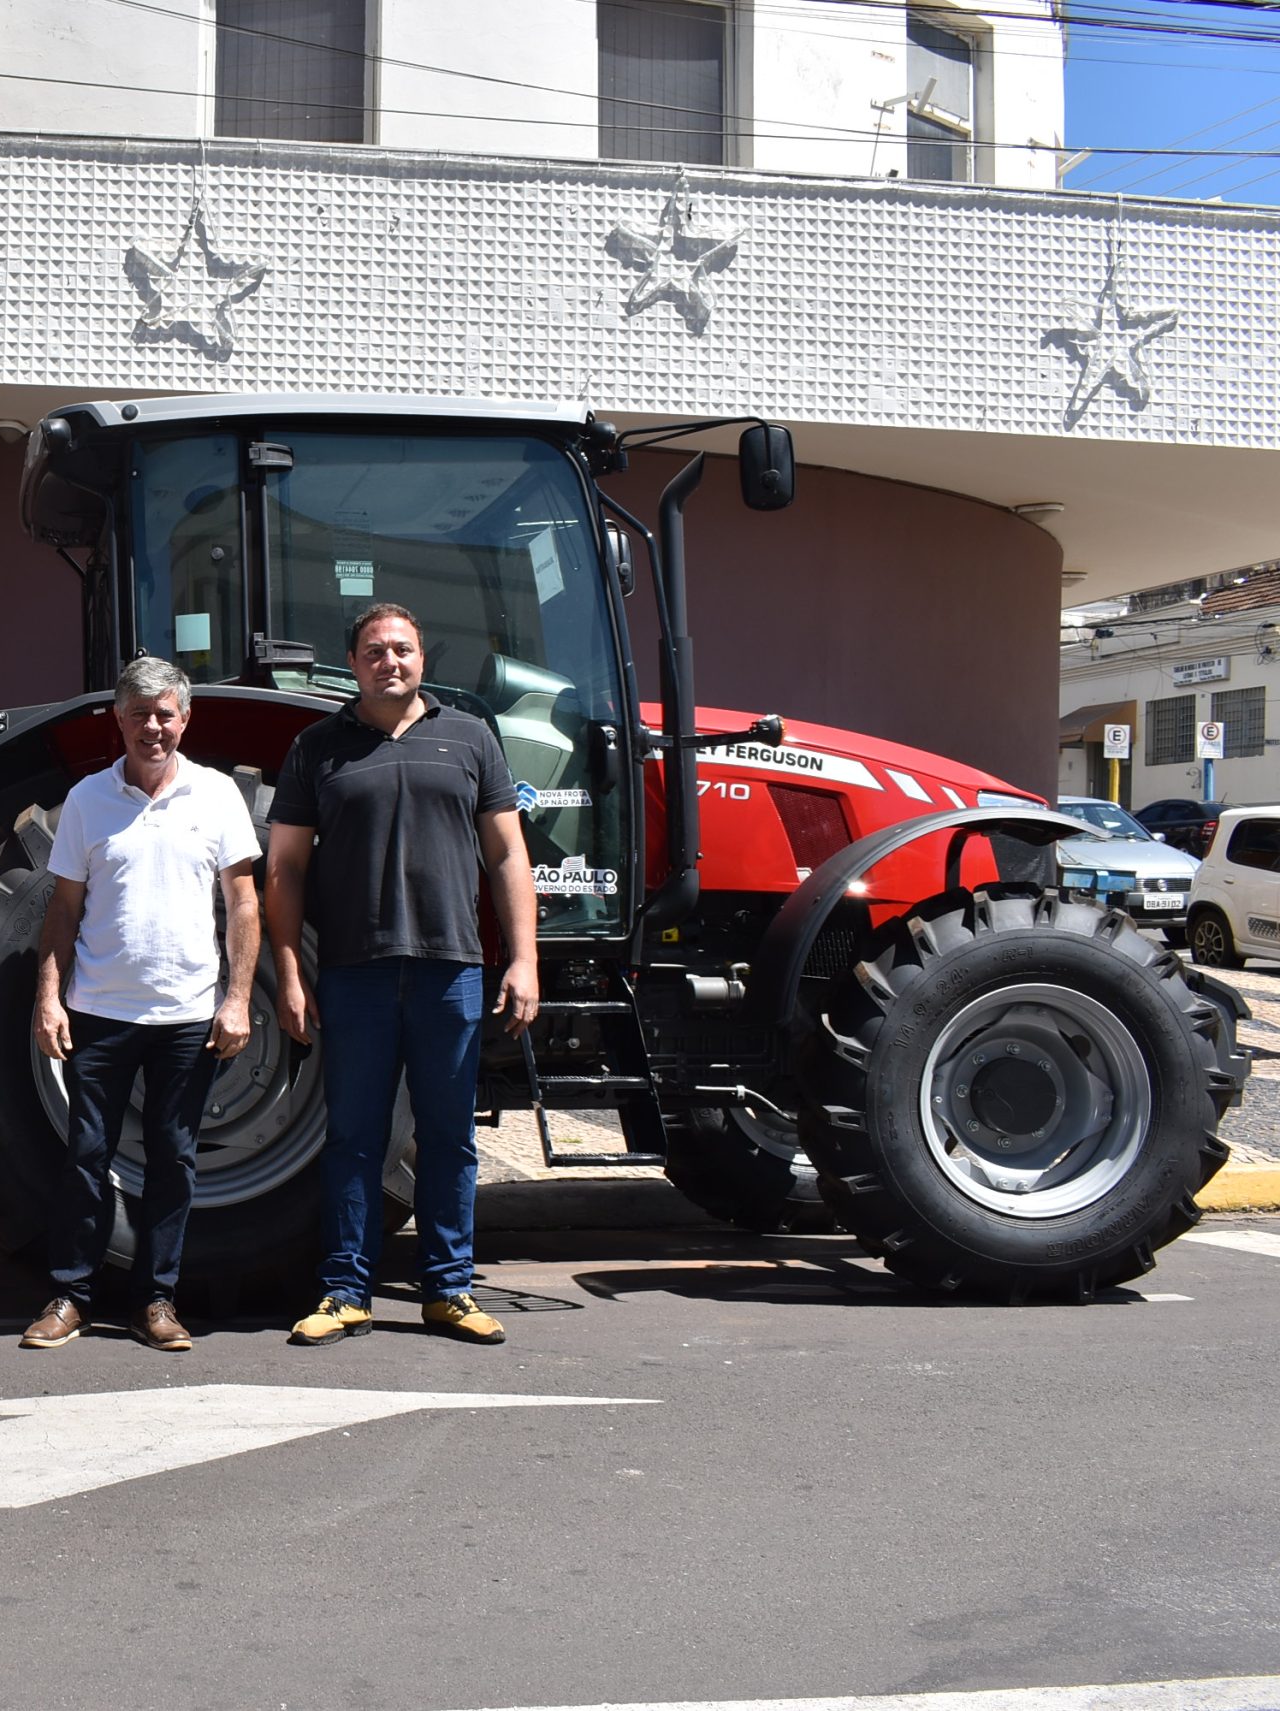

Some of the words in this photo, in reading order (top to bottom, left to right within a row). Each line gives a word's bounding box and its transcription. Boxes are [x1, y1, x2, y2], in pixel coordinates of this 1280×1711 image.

[1113, 730, 1121, 741] E
[1207, 727, 1215, 736] E
[725, 744, 823, 771] FERGUSON
[539, 790, 562, 799] NOVA
[564, 790, 588, 798] FROTA
[696, 780, 751, 801] 710
[551, 797, 568, 806] NÃO
[570, 798, 591, 806] PARA
[563, 871, 616, 884] PAULO
[534, 885, 567, 893] OVERNO
[568, 885, 581, 893] DO
[583, 885, 616, 893] ESTADO
